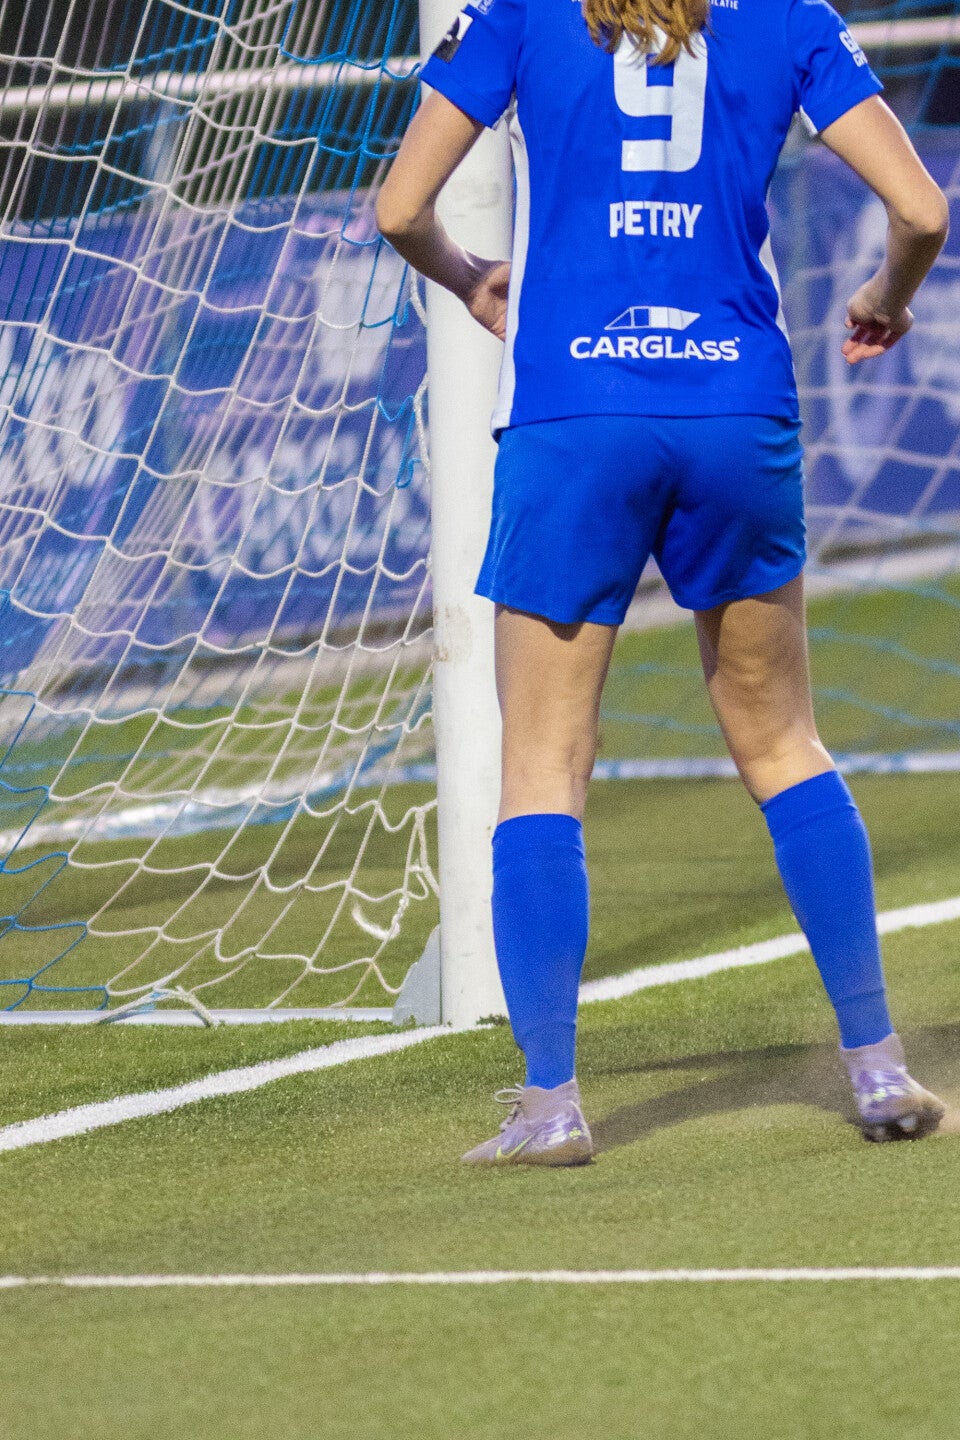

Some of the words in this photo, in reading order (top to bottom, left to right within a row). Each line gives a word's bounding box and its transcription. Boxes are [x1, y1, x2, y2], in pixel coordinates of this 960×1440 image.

[613, 23, 708, 173] 9
[609, 200, 702, 239] PETRY
[569, 335, 740, 362] CARGLASS
